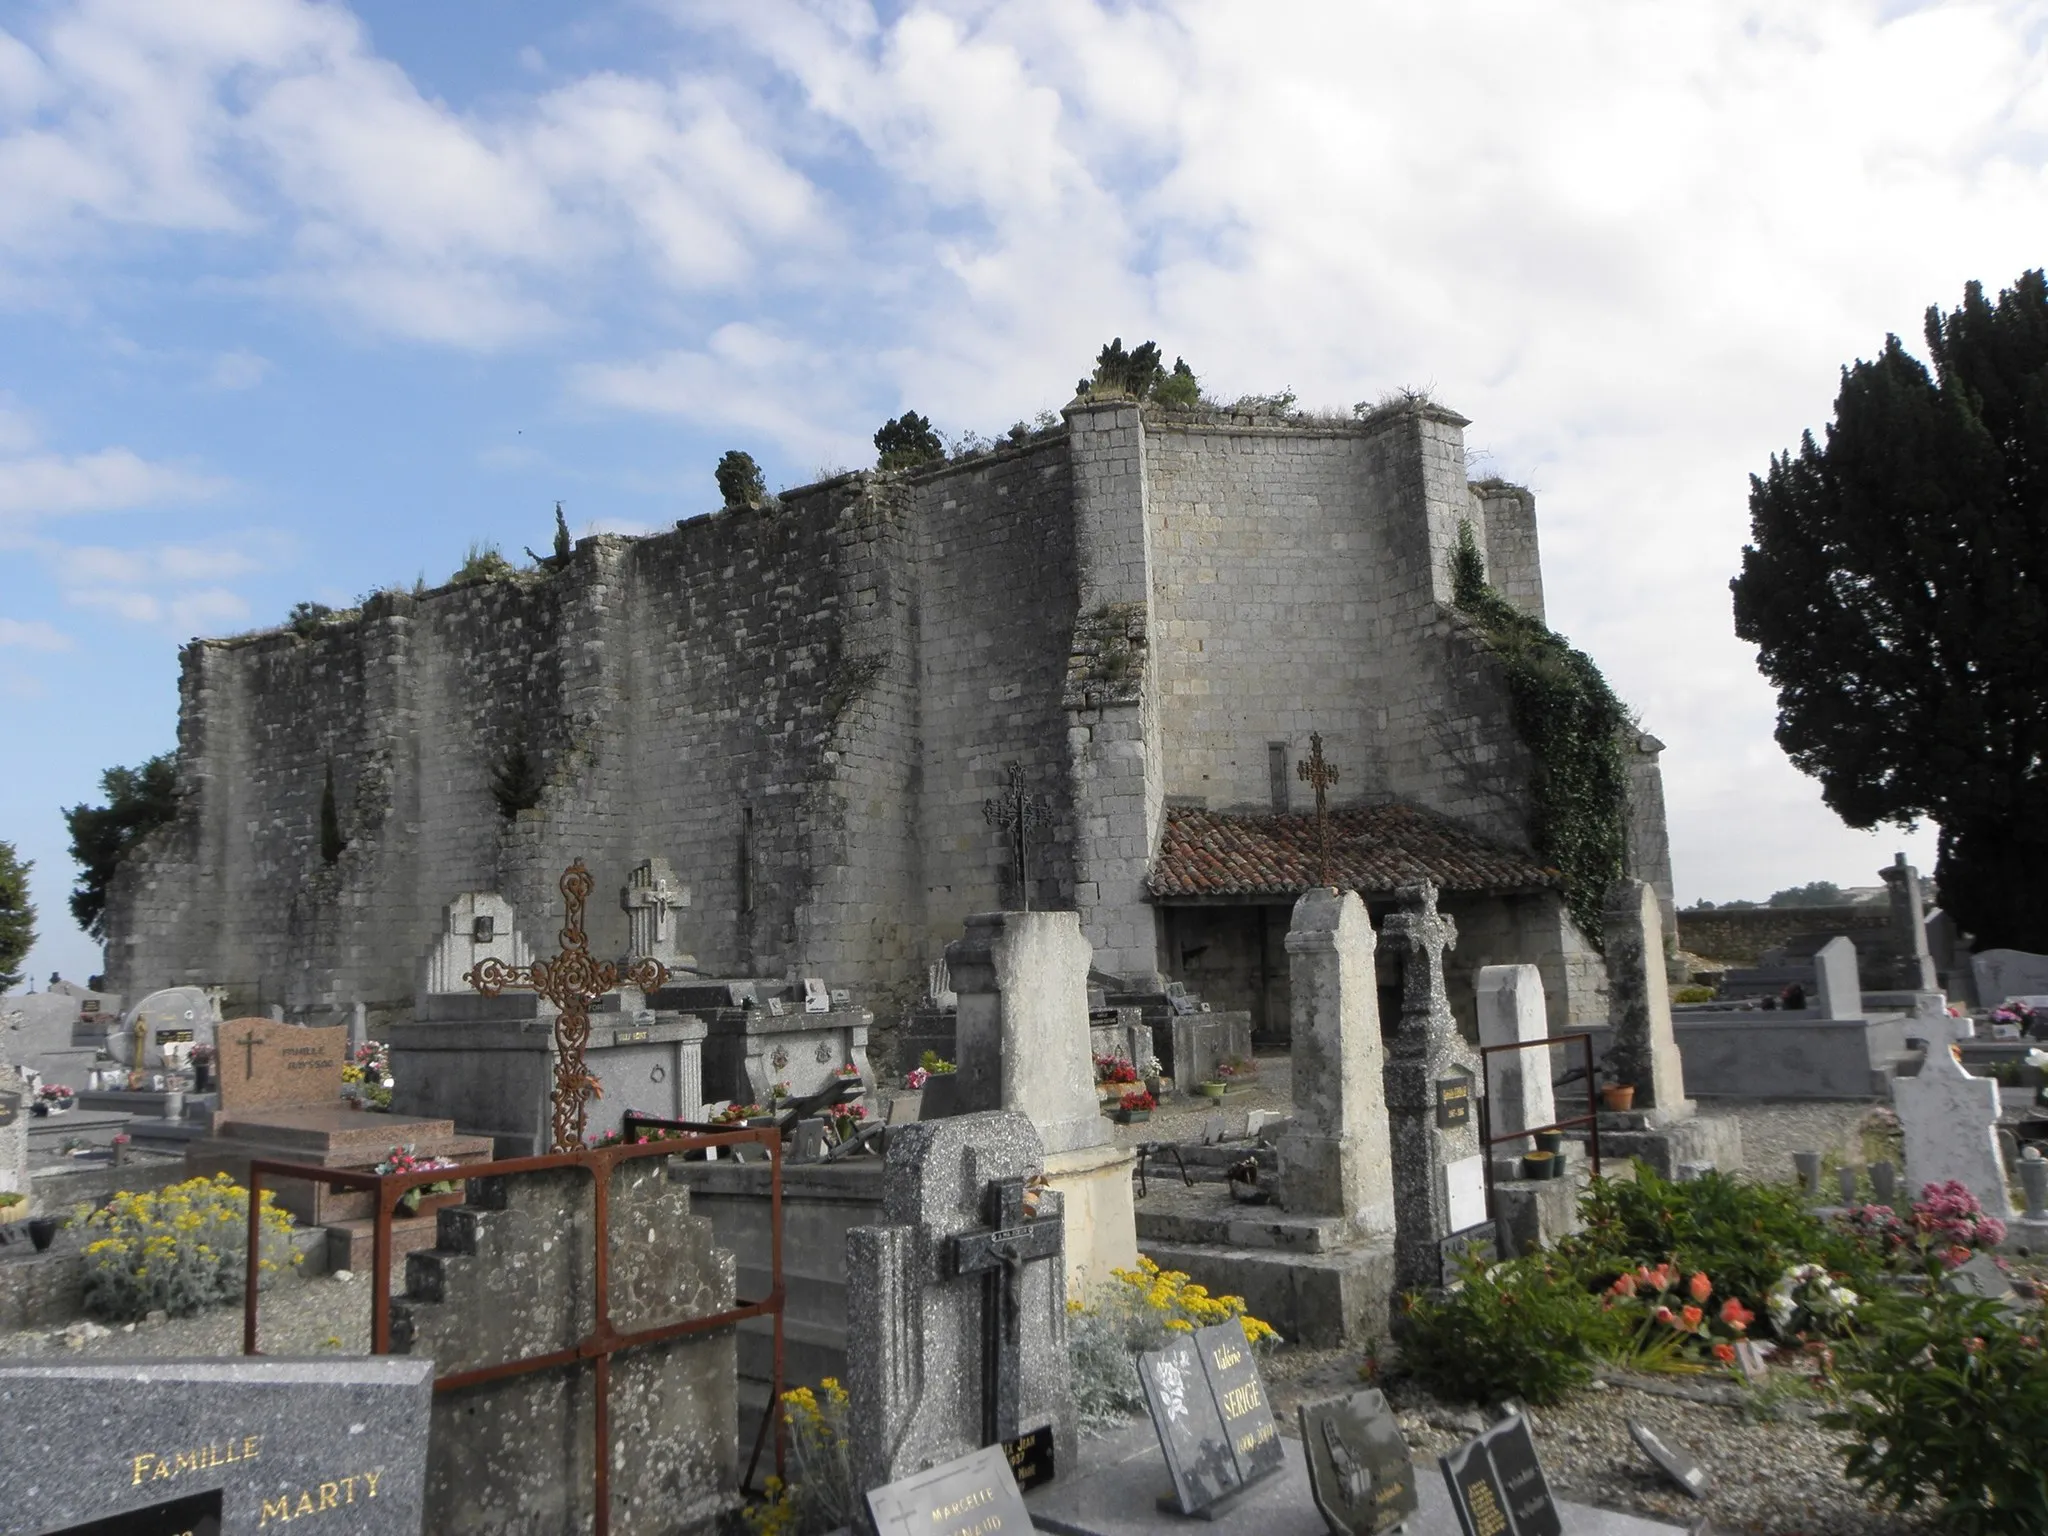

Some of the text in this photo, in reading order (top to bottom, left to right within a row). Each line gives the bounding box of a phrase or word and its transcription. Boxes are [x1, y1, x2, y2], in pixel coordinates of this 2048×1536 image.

[131, 1435, 261, 1486] FAMILLE
[260, 1471, 382, 1527] MARTY
[932, 1487, 995, 1523] MARCELLE
